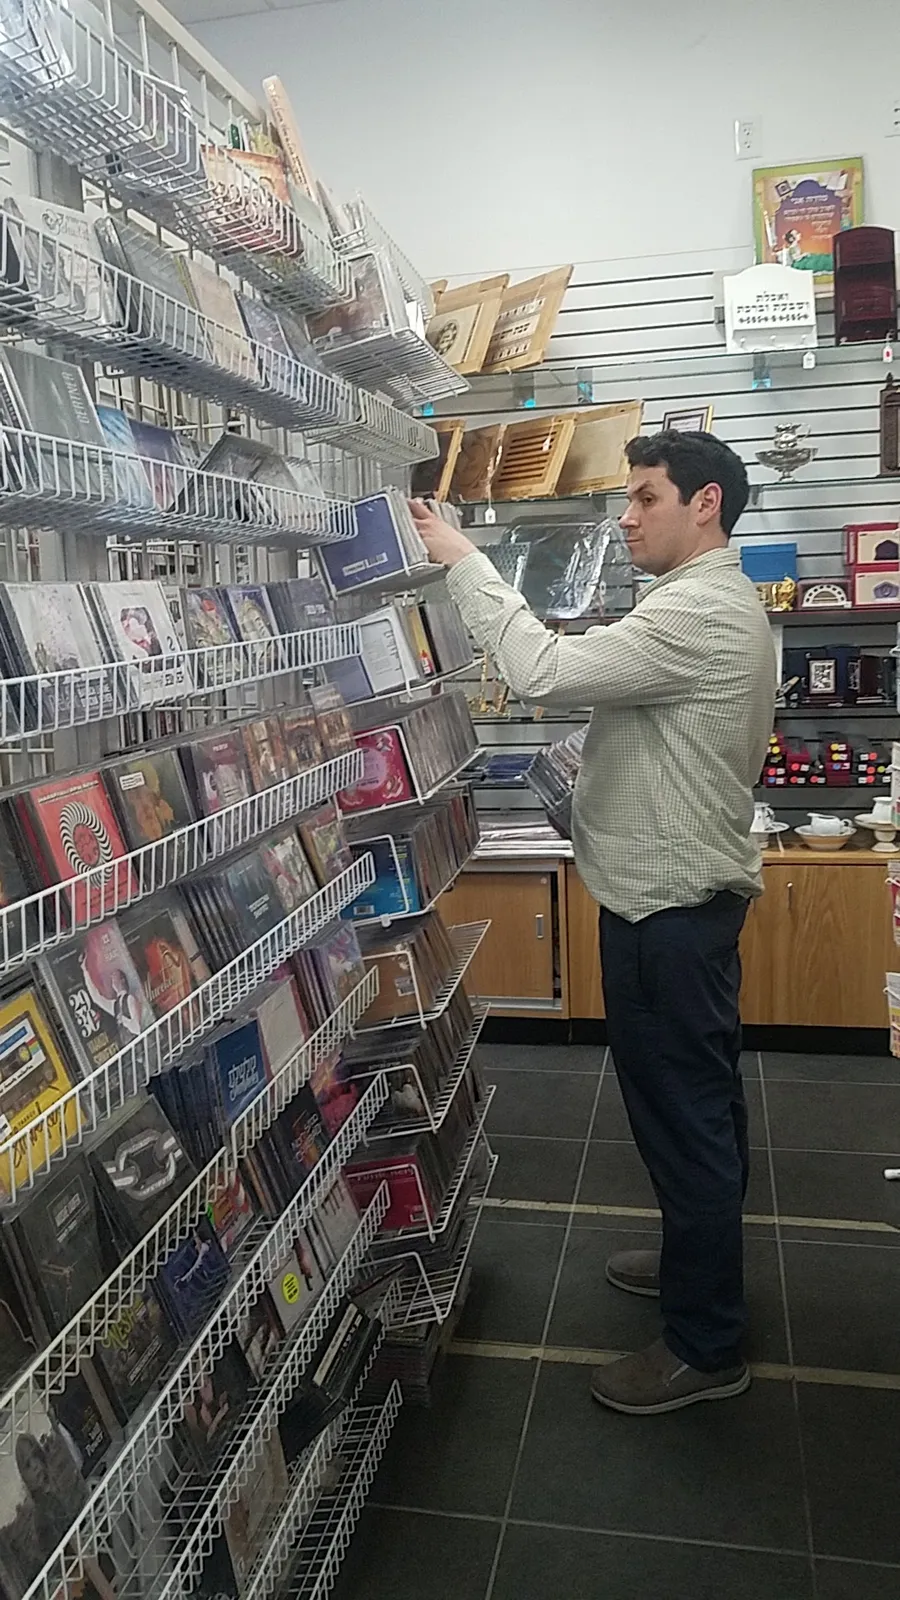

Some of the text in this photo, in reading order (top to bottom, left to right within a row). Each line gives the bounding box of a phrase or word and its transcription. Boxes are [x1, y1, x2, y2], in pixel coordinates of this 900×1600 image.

[756, 291, 789, 302] ואכלת
[737, 301, 809, 314] ושבעת וברכת
